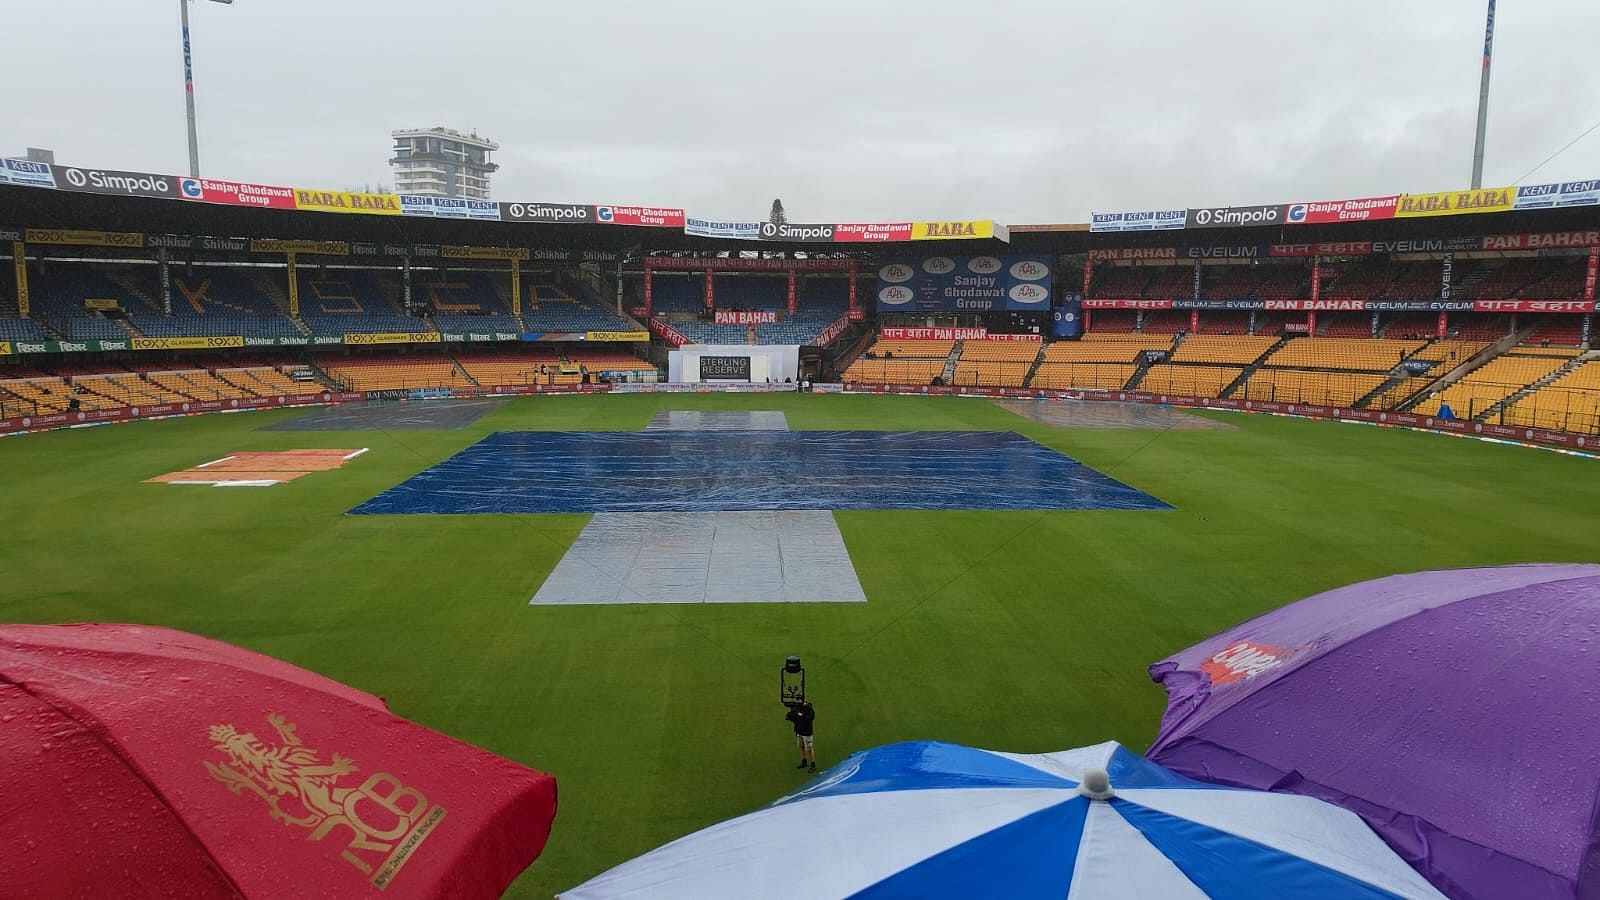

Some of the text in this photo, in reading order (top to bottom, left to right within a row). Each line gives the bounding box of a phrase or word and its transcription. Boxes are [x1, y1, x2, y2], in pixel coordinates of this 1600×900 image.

[10, 161, 42, 173] KENT
[88, 172, 168, 192] Simpolo
[1566, 181, 1596, 192] KENT
[203, 181, 292, 198] Sanjay Ghodawat
[1523, 185, 1553, 196] KENT
[239, 194, 270, 205] Group
[405, 197, 427, 205] KENT
[439, 199, 461, 207] KENT
[471, 201, 493, 209] KENT
[1309, 198, 1397, 214] Sanjay Ghodawat
[528, 205, 586, 220] Simpolo
[614, 207, 682, 218] Sanjay Ghodawat
[1214, 209, 1277, 225] Simpolo
[1339, 210, 1370, 220] Group
[641, 215, 664, 224] Group
[779, 225, 832, 240] Simpolo
[868, 224, 911, 232] Ghodawat
[27, 231, 64, 242] ROXX
[105, 234, 141, 246] ROXX
[864, 232, 889, 240] Group
[1483, 232, 1600, 248] PAN BAHAR
[148, 236, 245, 250] Shikhar Shikhar
[253, 242, 284, 251] ROXX
[317, 243, 347, 253] ROXX
[1373, 240, 1442, 252] EVEIUM
[442, 248, 528, 258] ROXX ROXX
[534, 249, 616, 261] Shikhar Shikhar
[1089, 248, 1176, 259] PAN BAHAR
[1189, 246, 1257, 257] EVEIUM
[1442, 253, 1453, 298] EVEIUM
[954, 276, 996, 288] Sanjay
[944, 287, 1006, 297] Ghodawat
[956, 298, 992, 309] Group
[1265, 300, 1364, 309] PAN BAHAR
[1430, 302, 1474, 310] EVEIUM
[715, 312, 775, 323] PAN BAHAR
[816, 317, 850, 347] PAN BAHAR
[935, 329, 987, 340] PAN BAHAR
[134, 339, 169, 349] ROXX
[208, 337, 241, 346] ROXX
[245, 336, 342, 345] Shikhar Shikhar Shikhar
[346, 335, 376, 343] ROXX
[409, 334, 438, 342] ROXX
[701, 358, 746, 366] STERLING
[702, 366, 745, 374] RESERVE
[367, 391, 382, 400] RAJ
[383, 390, 408, 399] NIWAS
[1484, 425, 1516, 435] cricheroes
[1535, 431, 1567, 442] cricheroes
